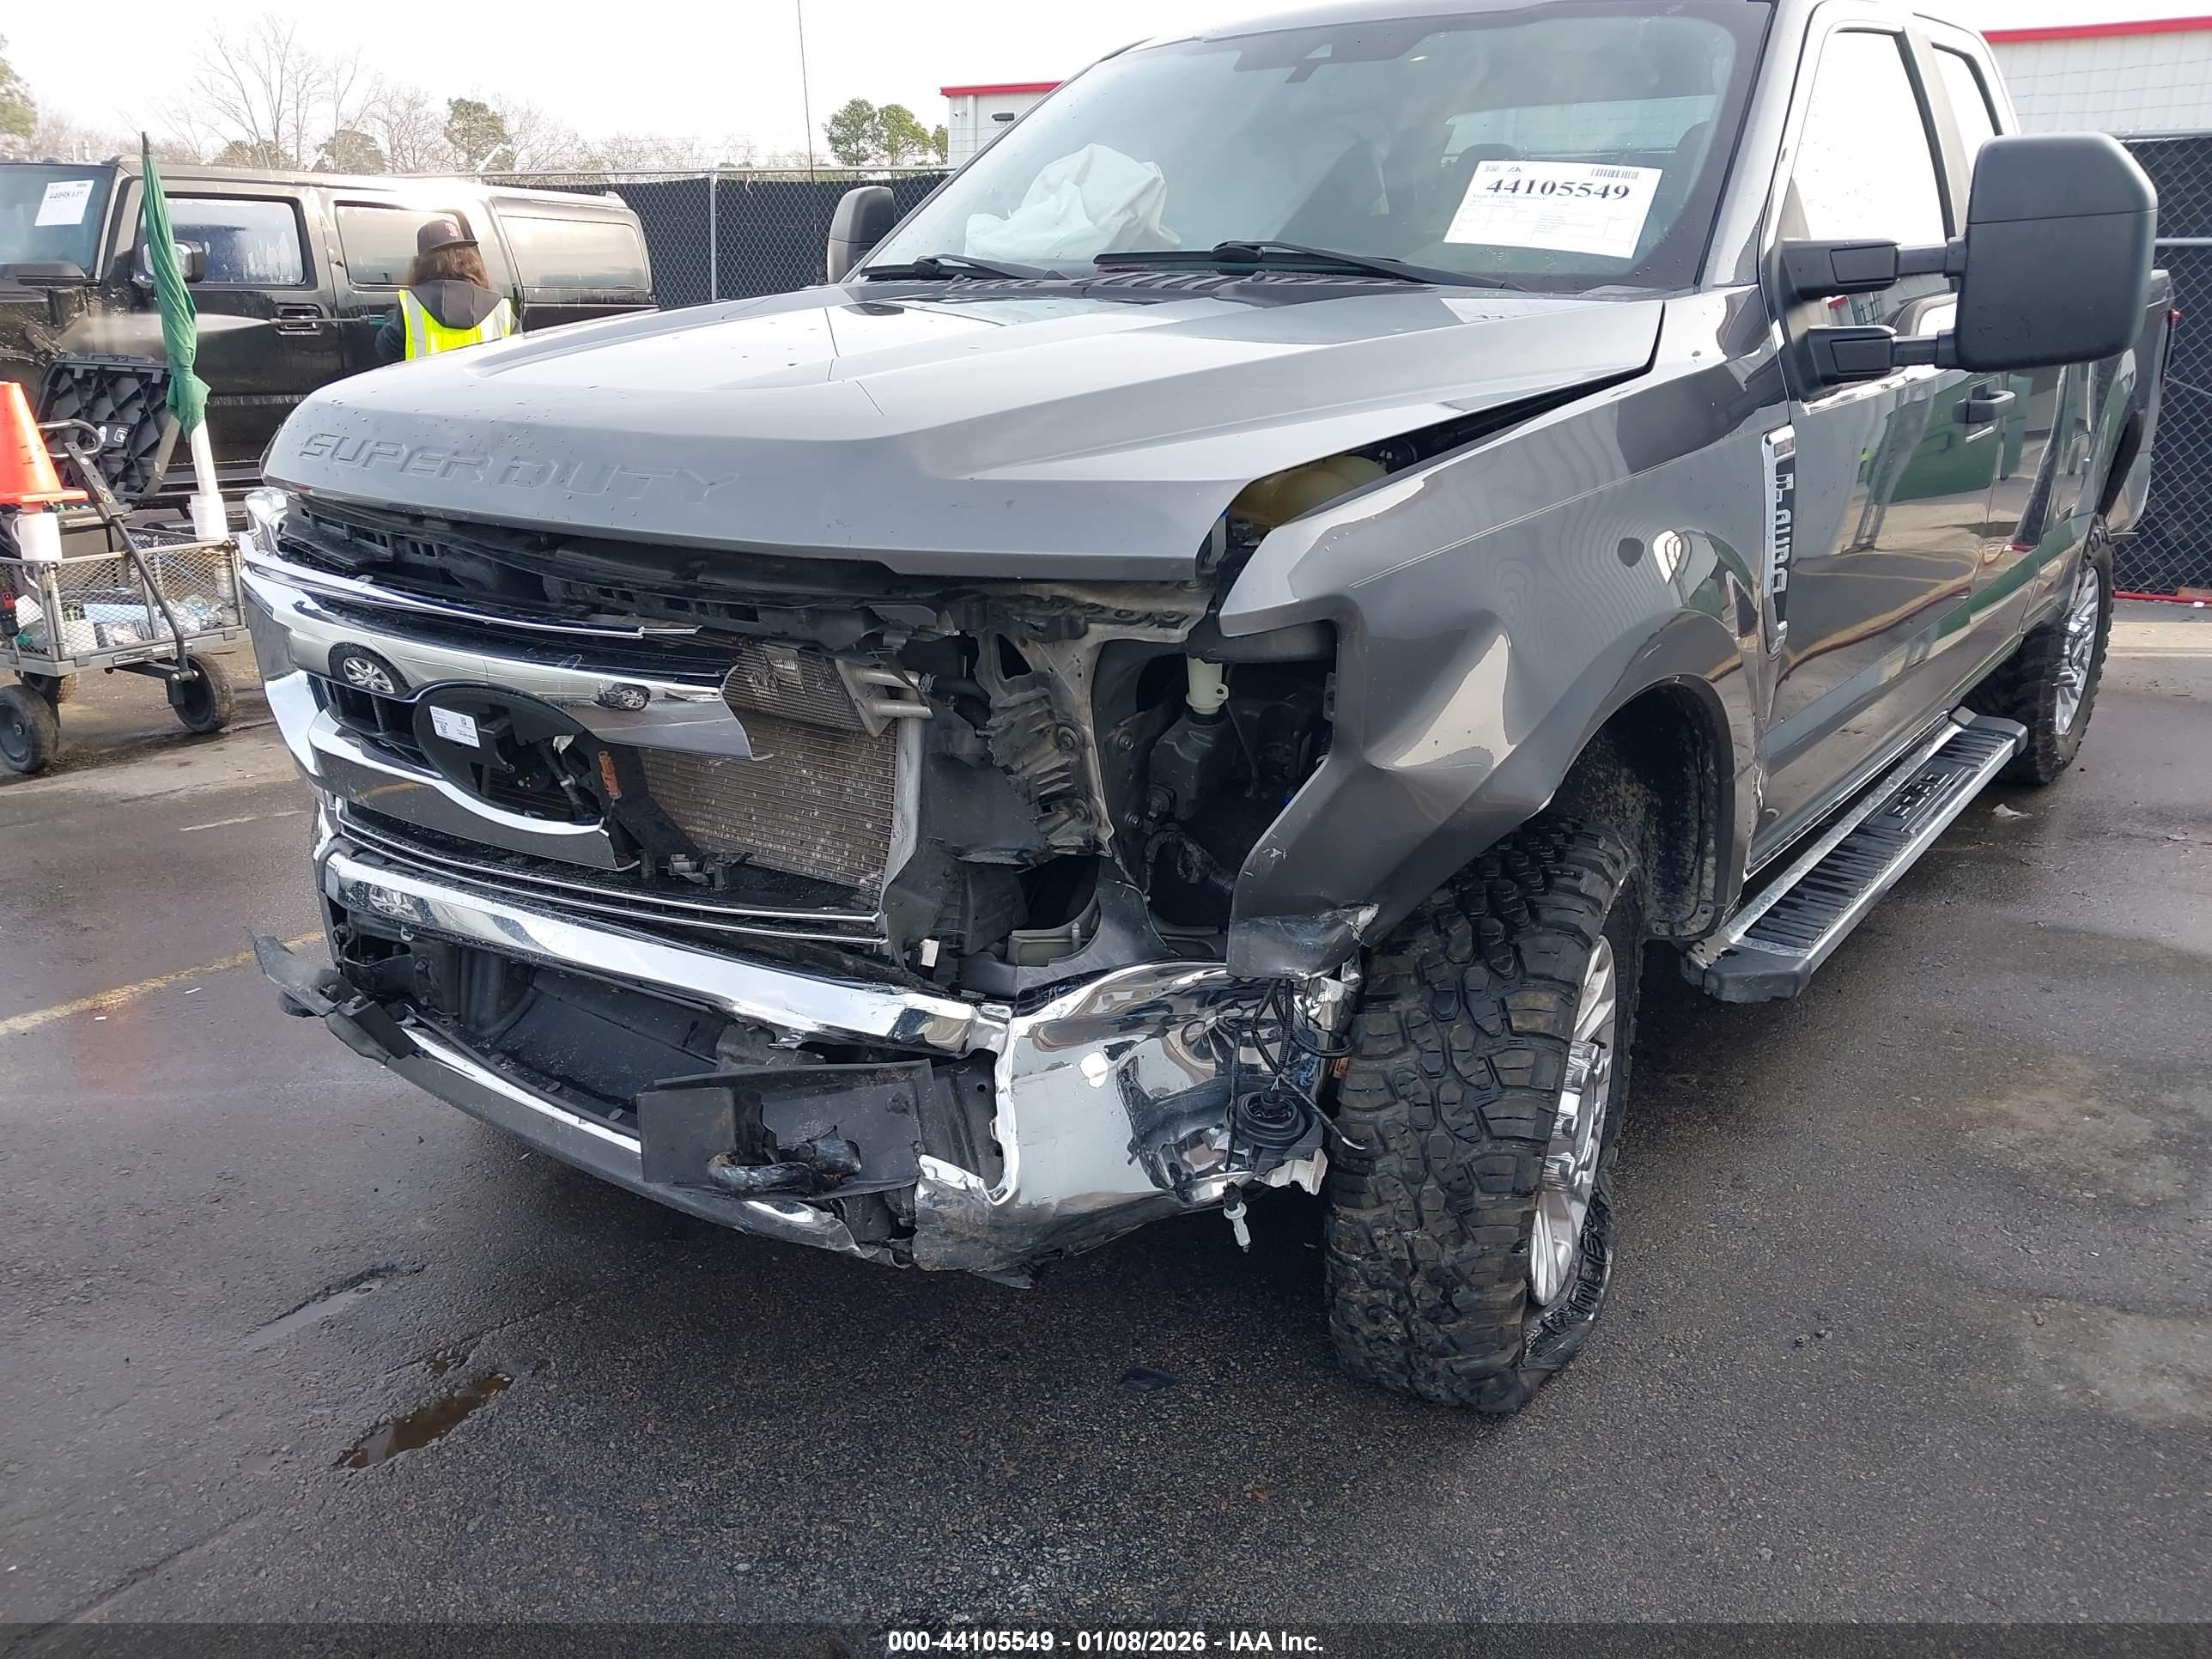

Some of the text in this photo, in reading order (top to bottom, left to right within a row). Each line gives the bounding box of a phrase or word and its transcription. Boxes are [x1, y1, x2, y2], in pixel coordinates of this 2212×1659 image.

[1486, 179, 1630, 200] 44105549
[299, 432, 738, 505] SUPER DUTY
